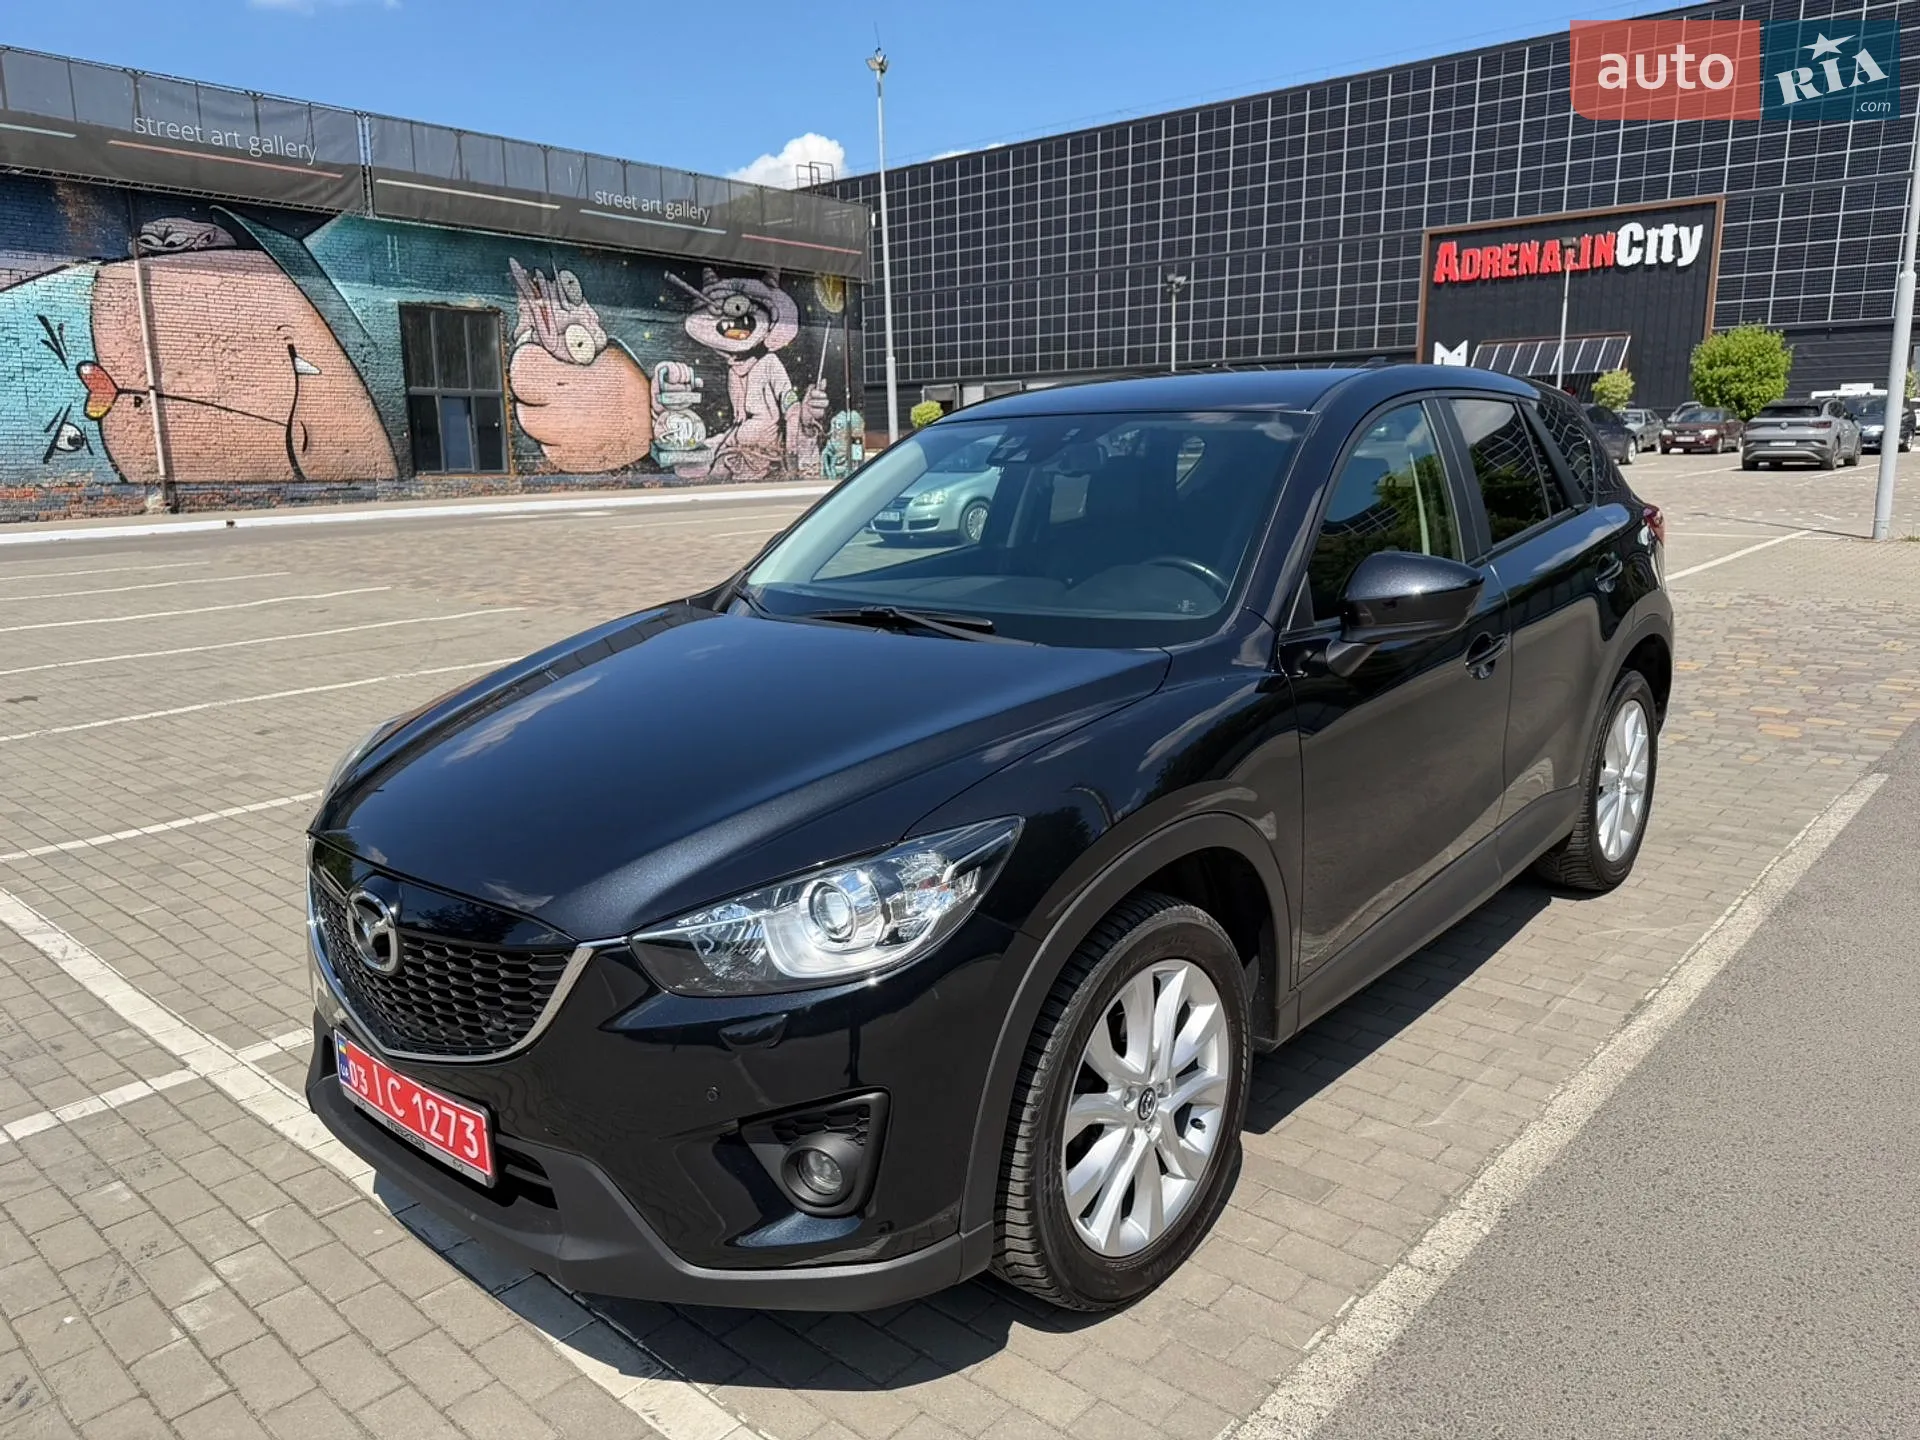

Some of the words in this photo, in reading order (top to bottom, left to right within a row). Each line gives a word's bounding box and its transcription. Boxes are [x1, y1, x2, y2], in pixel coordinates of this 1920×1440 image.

[134, 116, 204, 144] street
[211, 129, 243, 149] art
[249, 135, 318, 166] gallery
[594, 190, 638, 211] street
[641, 198, 663, 215] art
[665, 200, 711, 226] gallery
[348, 1060, 369, 1096] 03
[372, 1063, 405, 1118] IC
[412, 1092, 480, 1159] 1273
